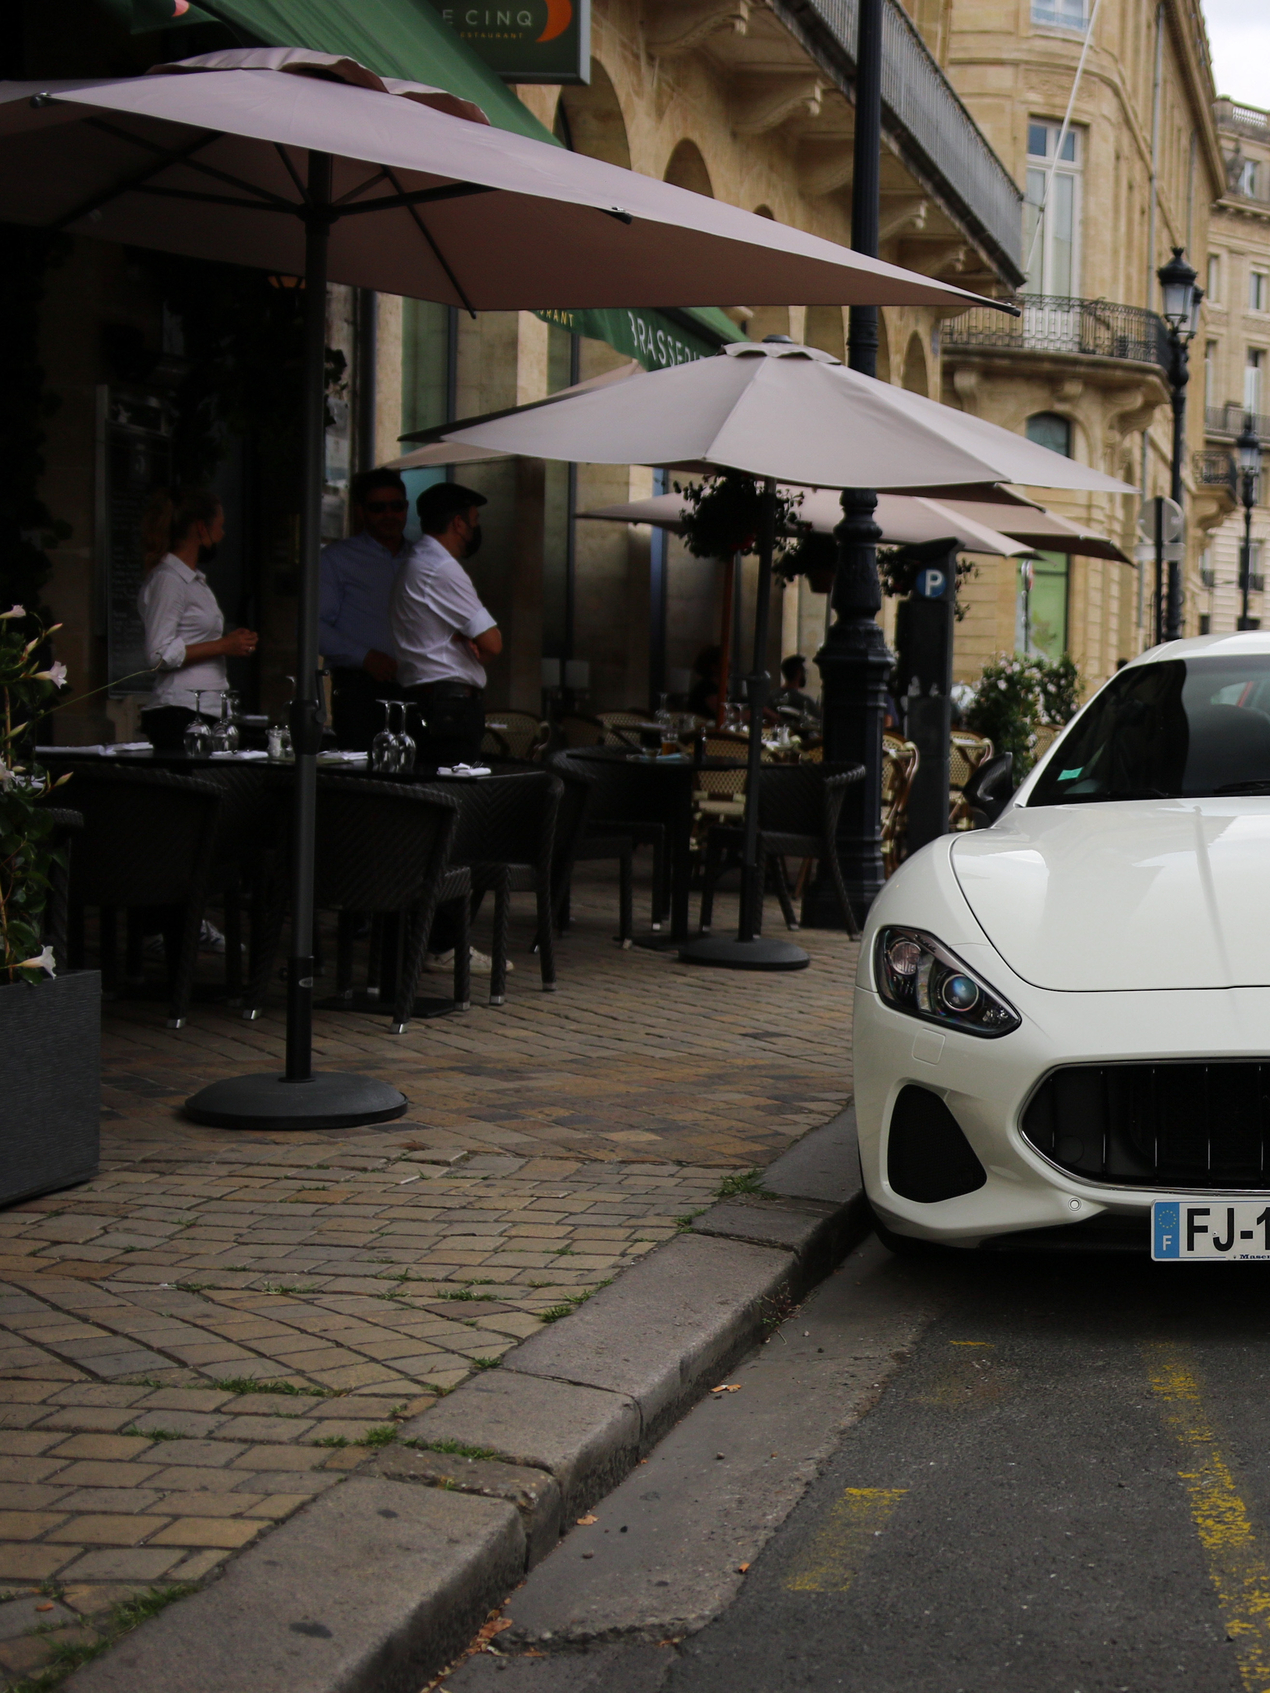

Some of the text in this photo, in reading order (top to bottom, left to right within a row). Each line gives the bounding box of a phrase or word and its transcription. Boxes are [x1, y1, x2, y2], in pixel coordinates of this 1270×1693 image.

[442, 9, 533, 28] E CINQ
[460, 31, 523, 39] ESTAURANT
[925, 569, 943, 596] P
[1162, 1235, 1172, 1251] F
